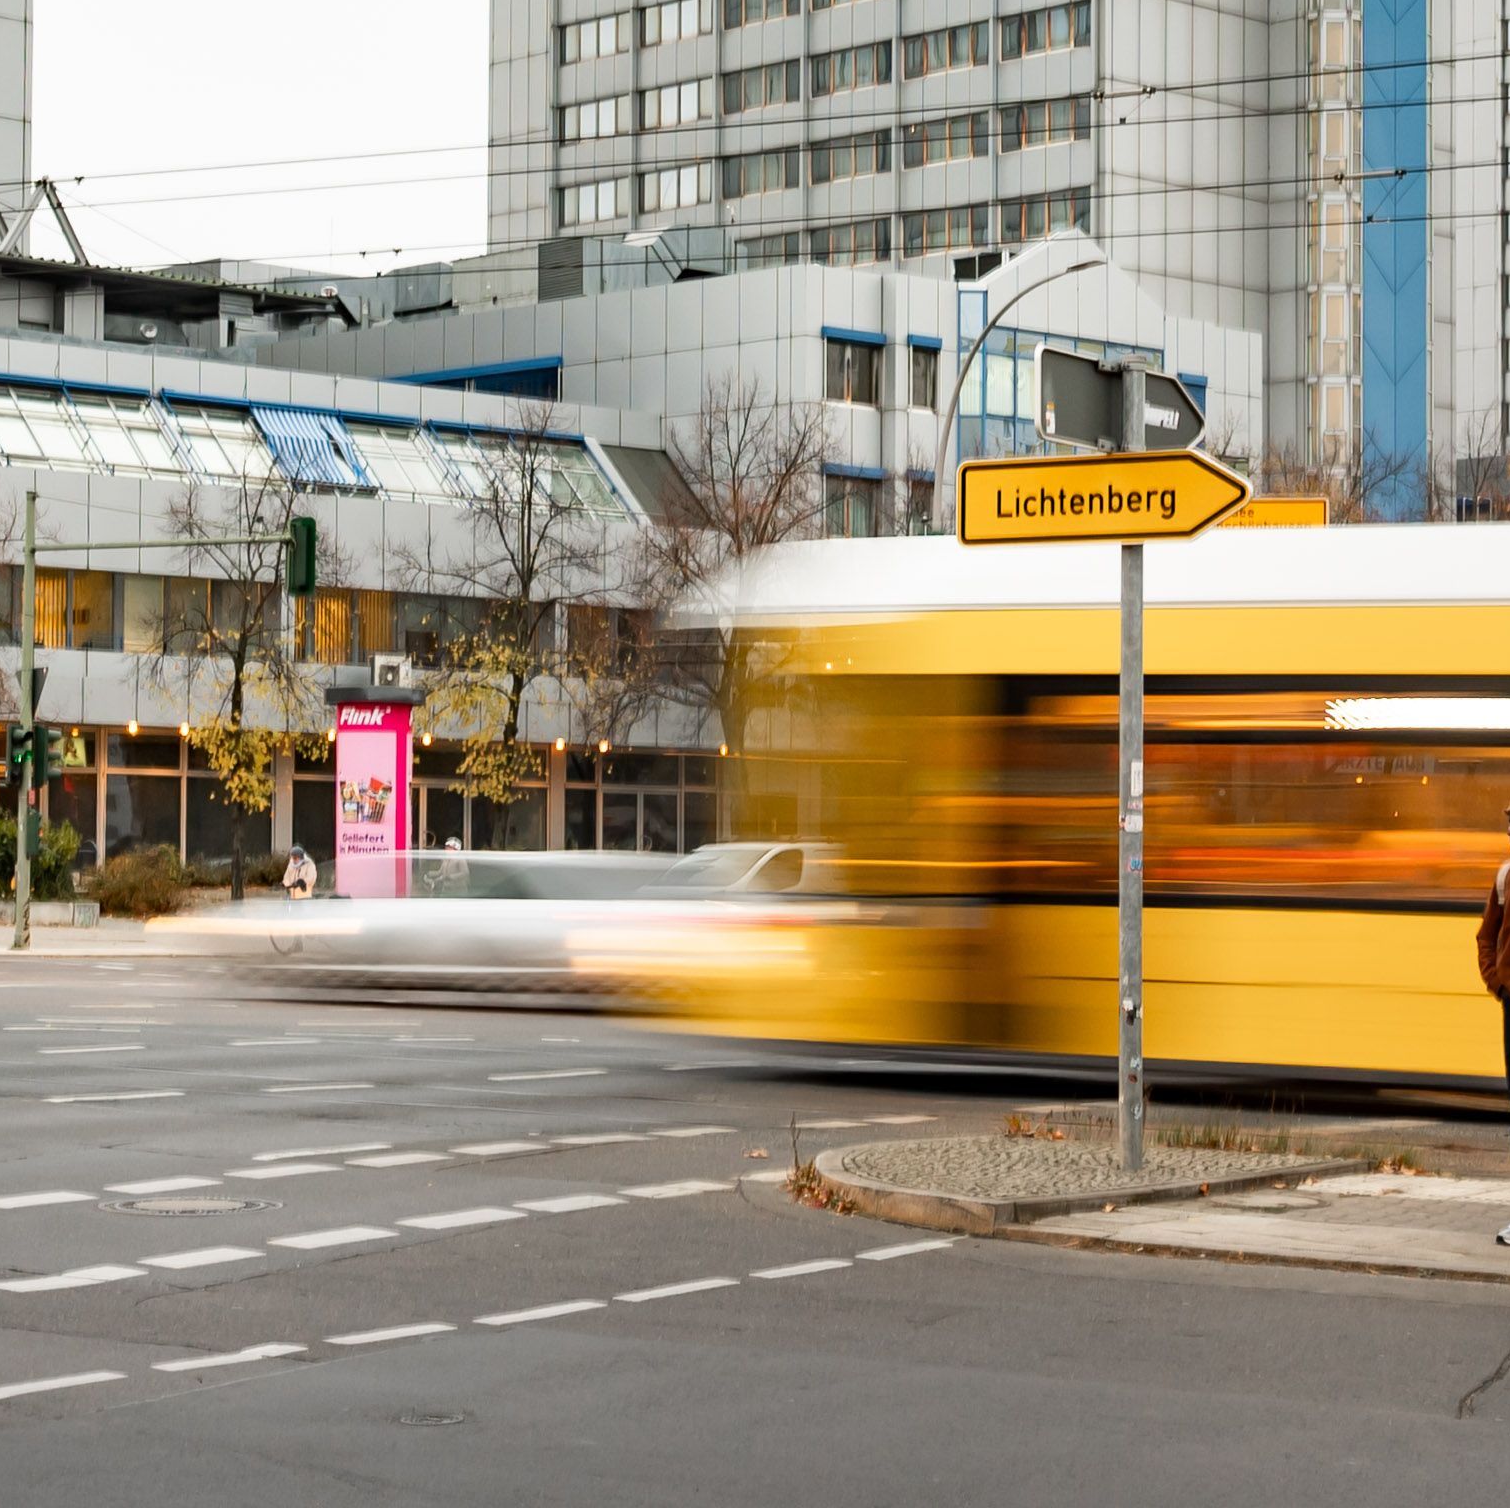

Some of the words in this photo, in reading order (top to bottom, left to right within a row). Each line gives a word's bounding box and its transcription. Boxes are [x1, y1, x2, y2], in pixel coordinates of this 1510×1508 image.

[996, 482, 1177, 520] Lichtenberg
[339, 705, 385, 726] Flink
[342, 833, 384, 843] Geliefert
